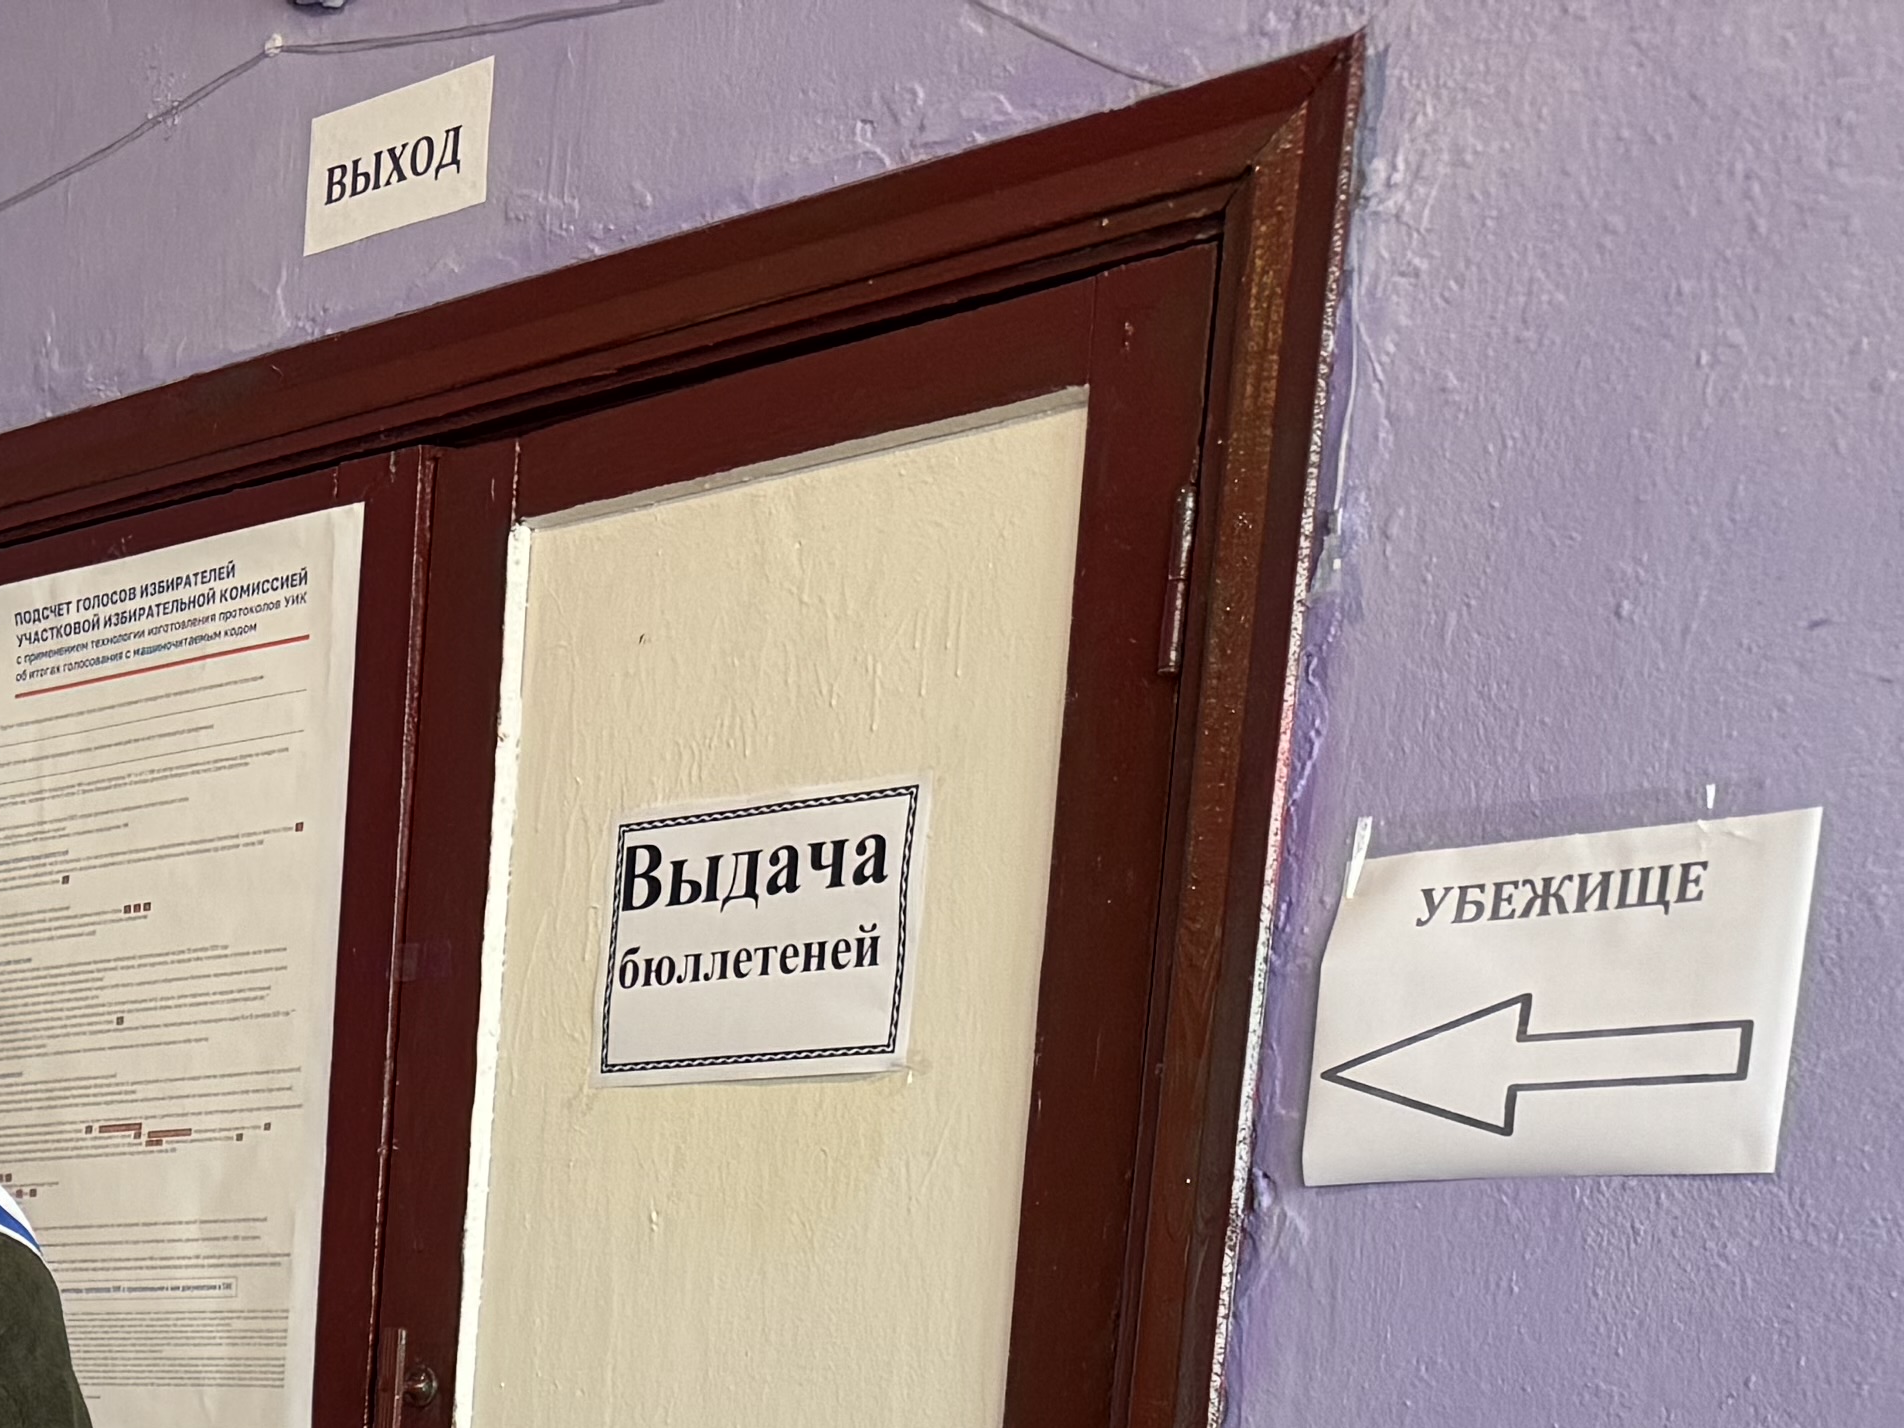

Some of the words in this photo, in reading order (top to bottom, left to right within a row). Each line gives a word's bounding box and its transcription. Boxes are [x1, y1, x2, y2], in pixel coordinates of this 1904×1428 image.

[324, 124, 463, 206] ВЫХОД
[14, 601, 72, 627] ПОДСЧЕТ
[76, 586, 137, 613] ГОЛОСОВ
[140, 560, 236, 599] ИЗБИРАТЕЛЕЙ
[16, 614, 100, 648] УЧАСТКОВОЙ
[103, 588, 216, 629] ИЗБИРАТЕЛЬНОЙ
[219, 566, 308, 603] КОМИССИЕЙ
[218, 600, 281, 623] протоколов
[284, 591, 307, 609] УИК
[15, 669, 27, 682] об
[223, 622, 257, 639] кодом
[621, 832, 889, 913] Выдача
[1415, 860, 1710, 928] УБЕЖИЩЕ
[618, 922, 882, 990] бюллетеней
